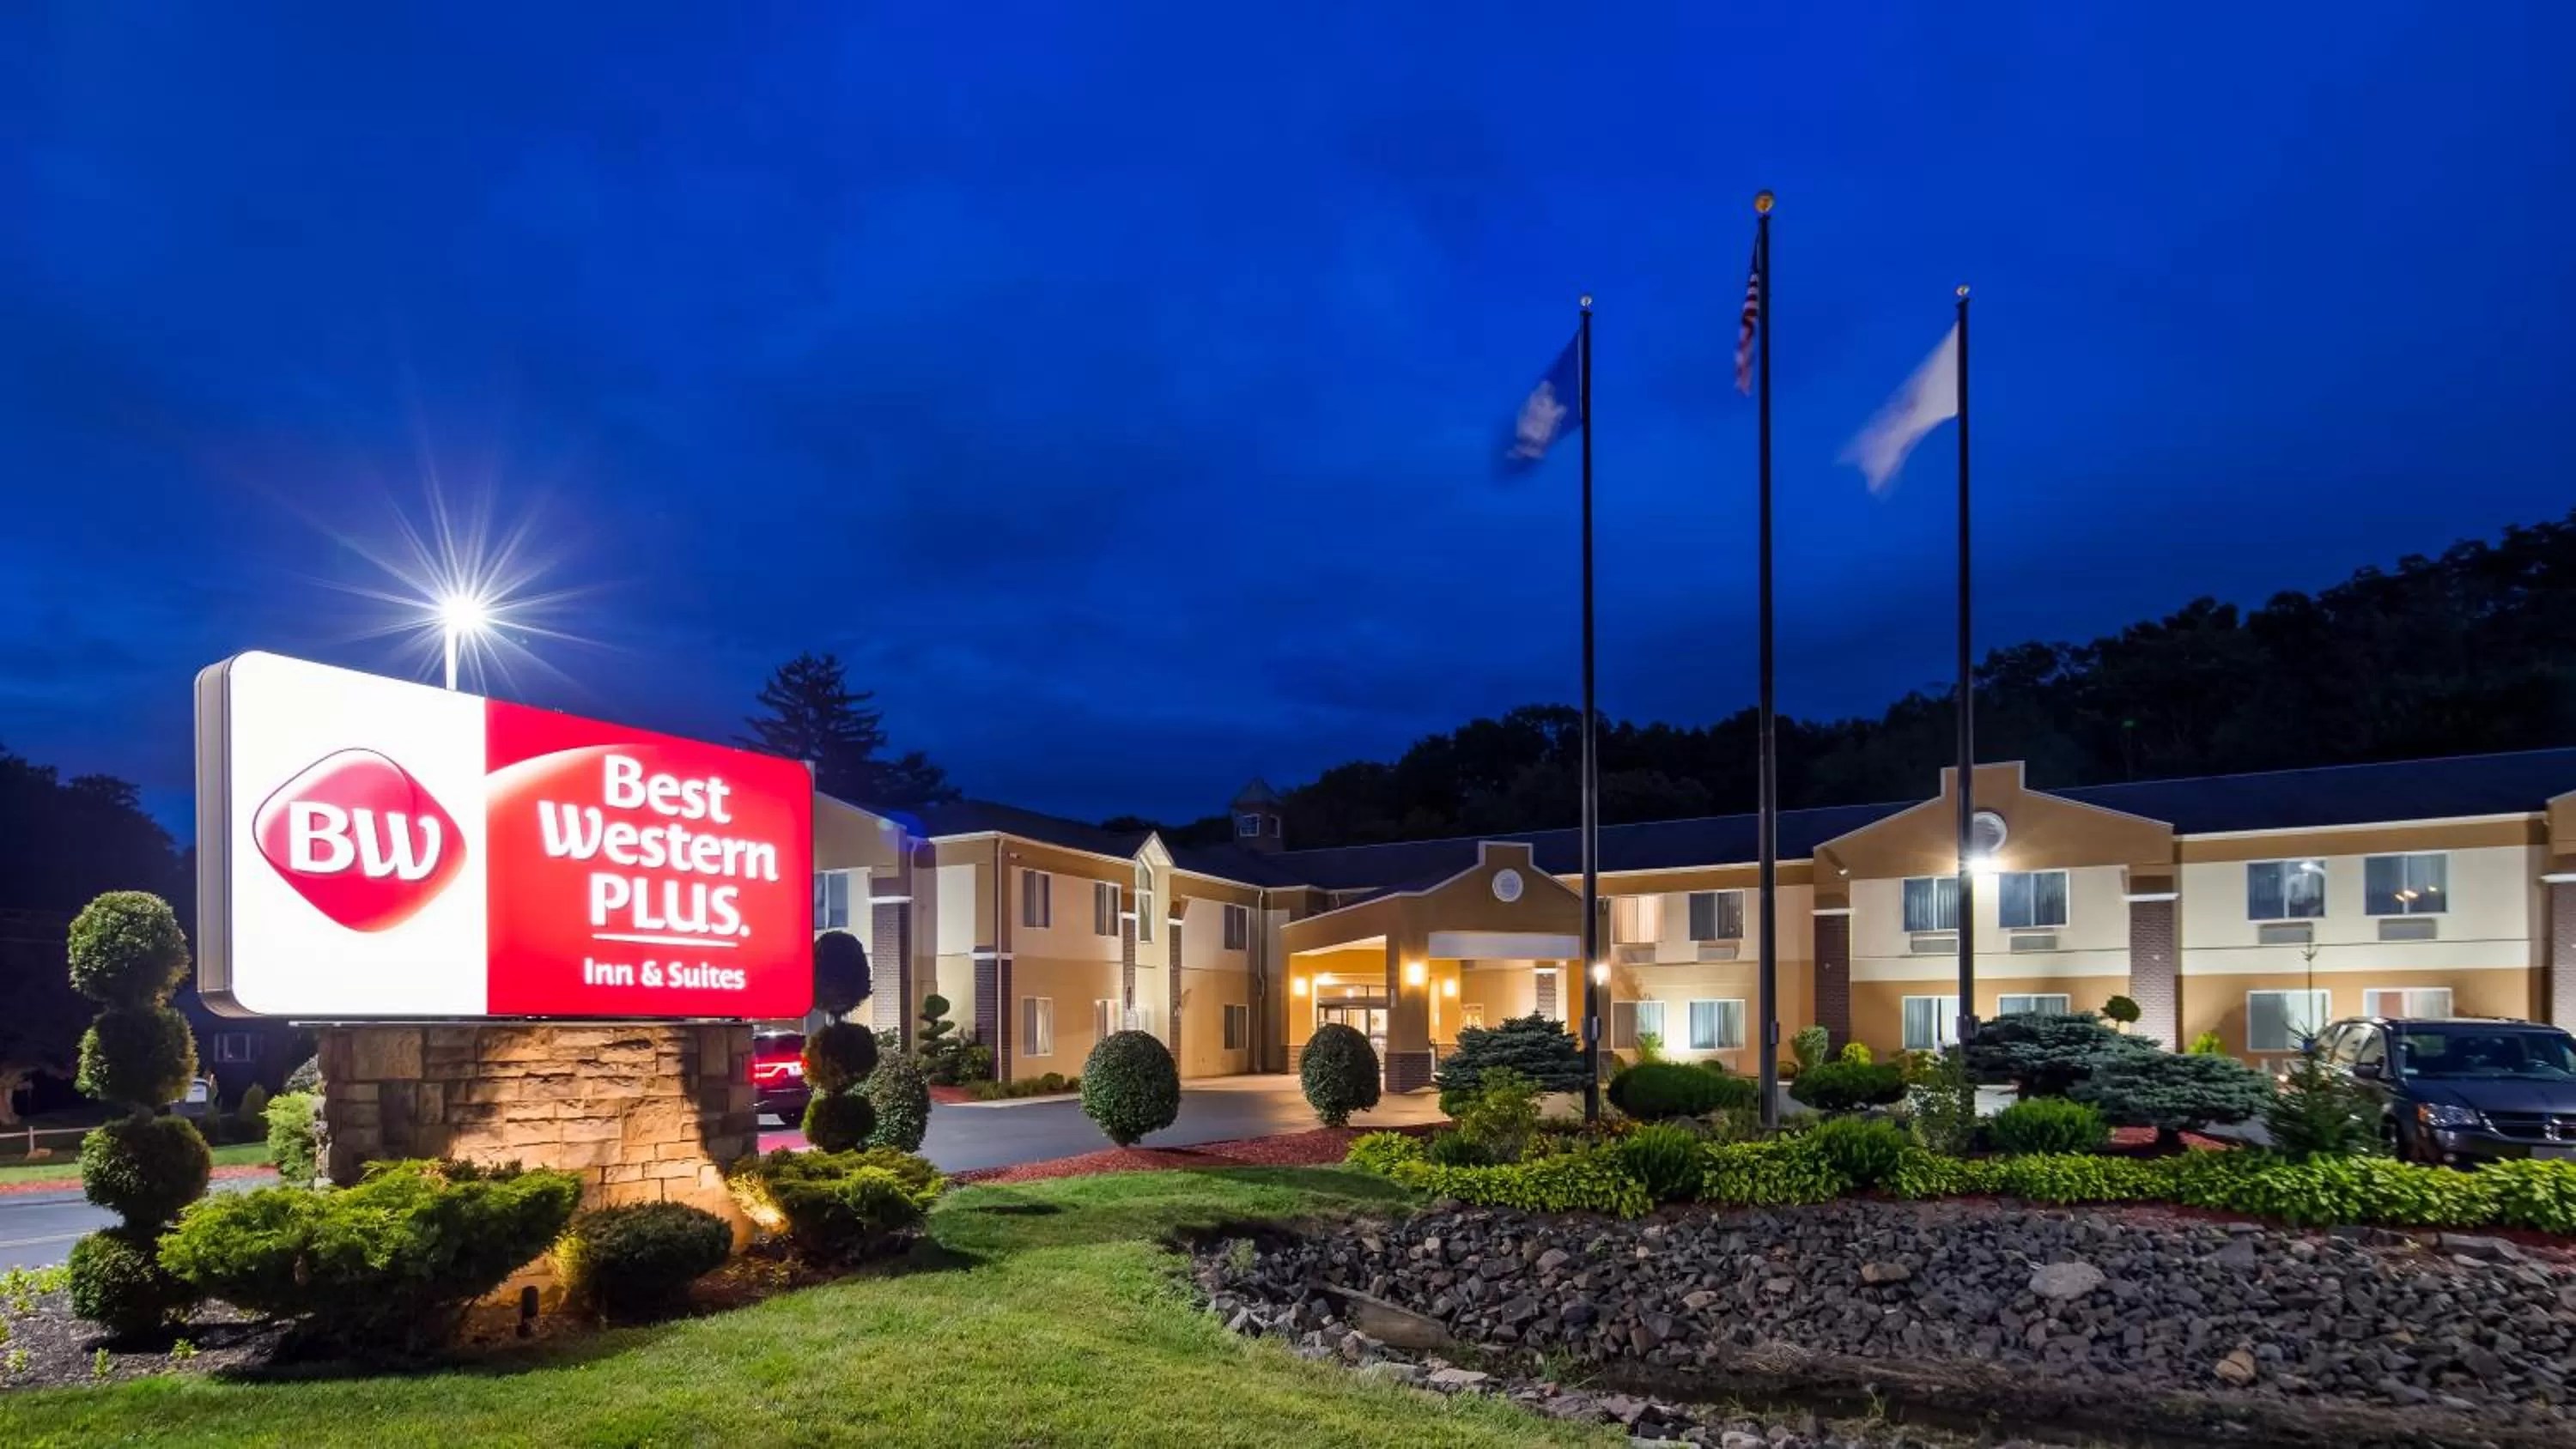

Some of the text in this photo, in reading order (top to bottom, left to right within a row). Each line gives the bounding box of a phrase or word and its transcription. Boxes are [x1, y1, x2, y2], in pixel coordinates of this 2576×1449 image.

[605, 754, 732, 824] Best
[288, 800, 441, 882] BW
[538, 799, 780, 882] Western
[584, 957, 745, 990] Inn & Suites
